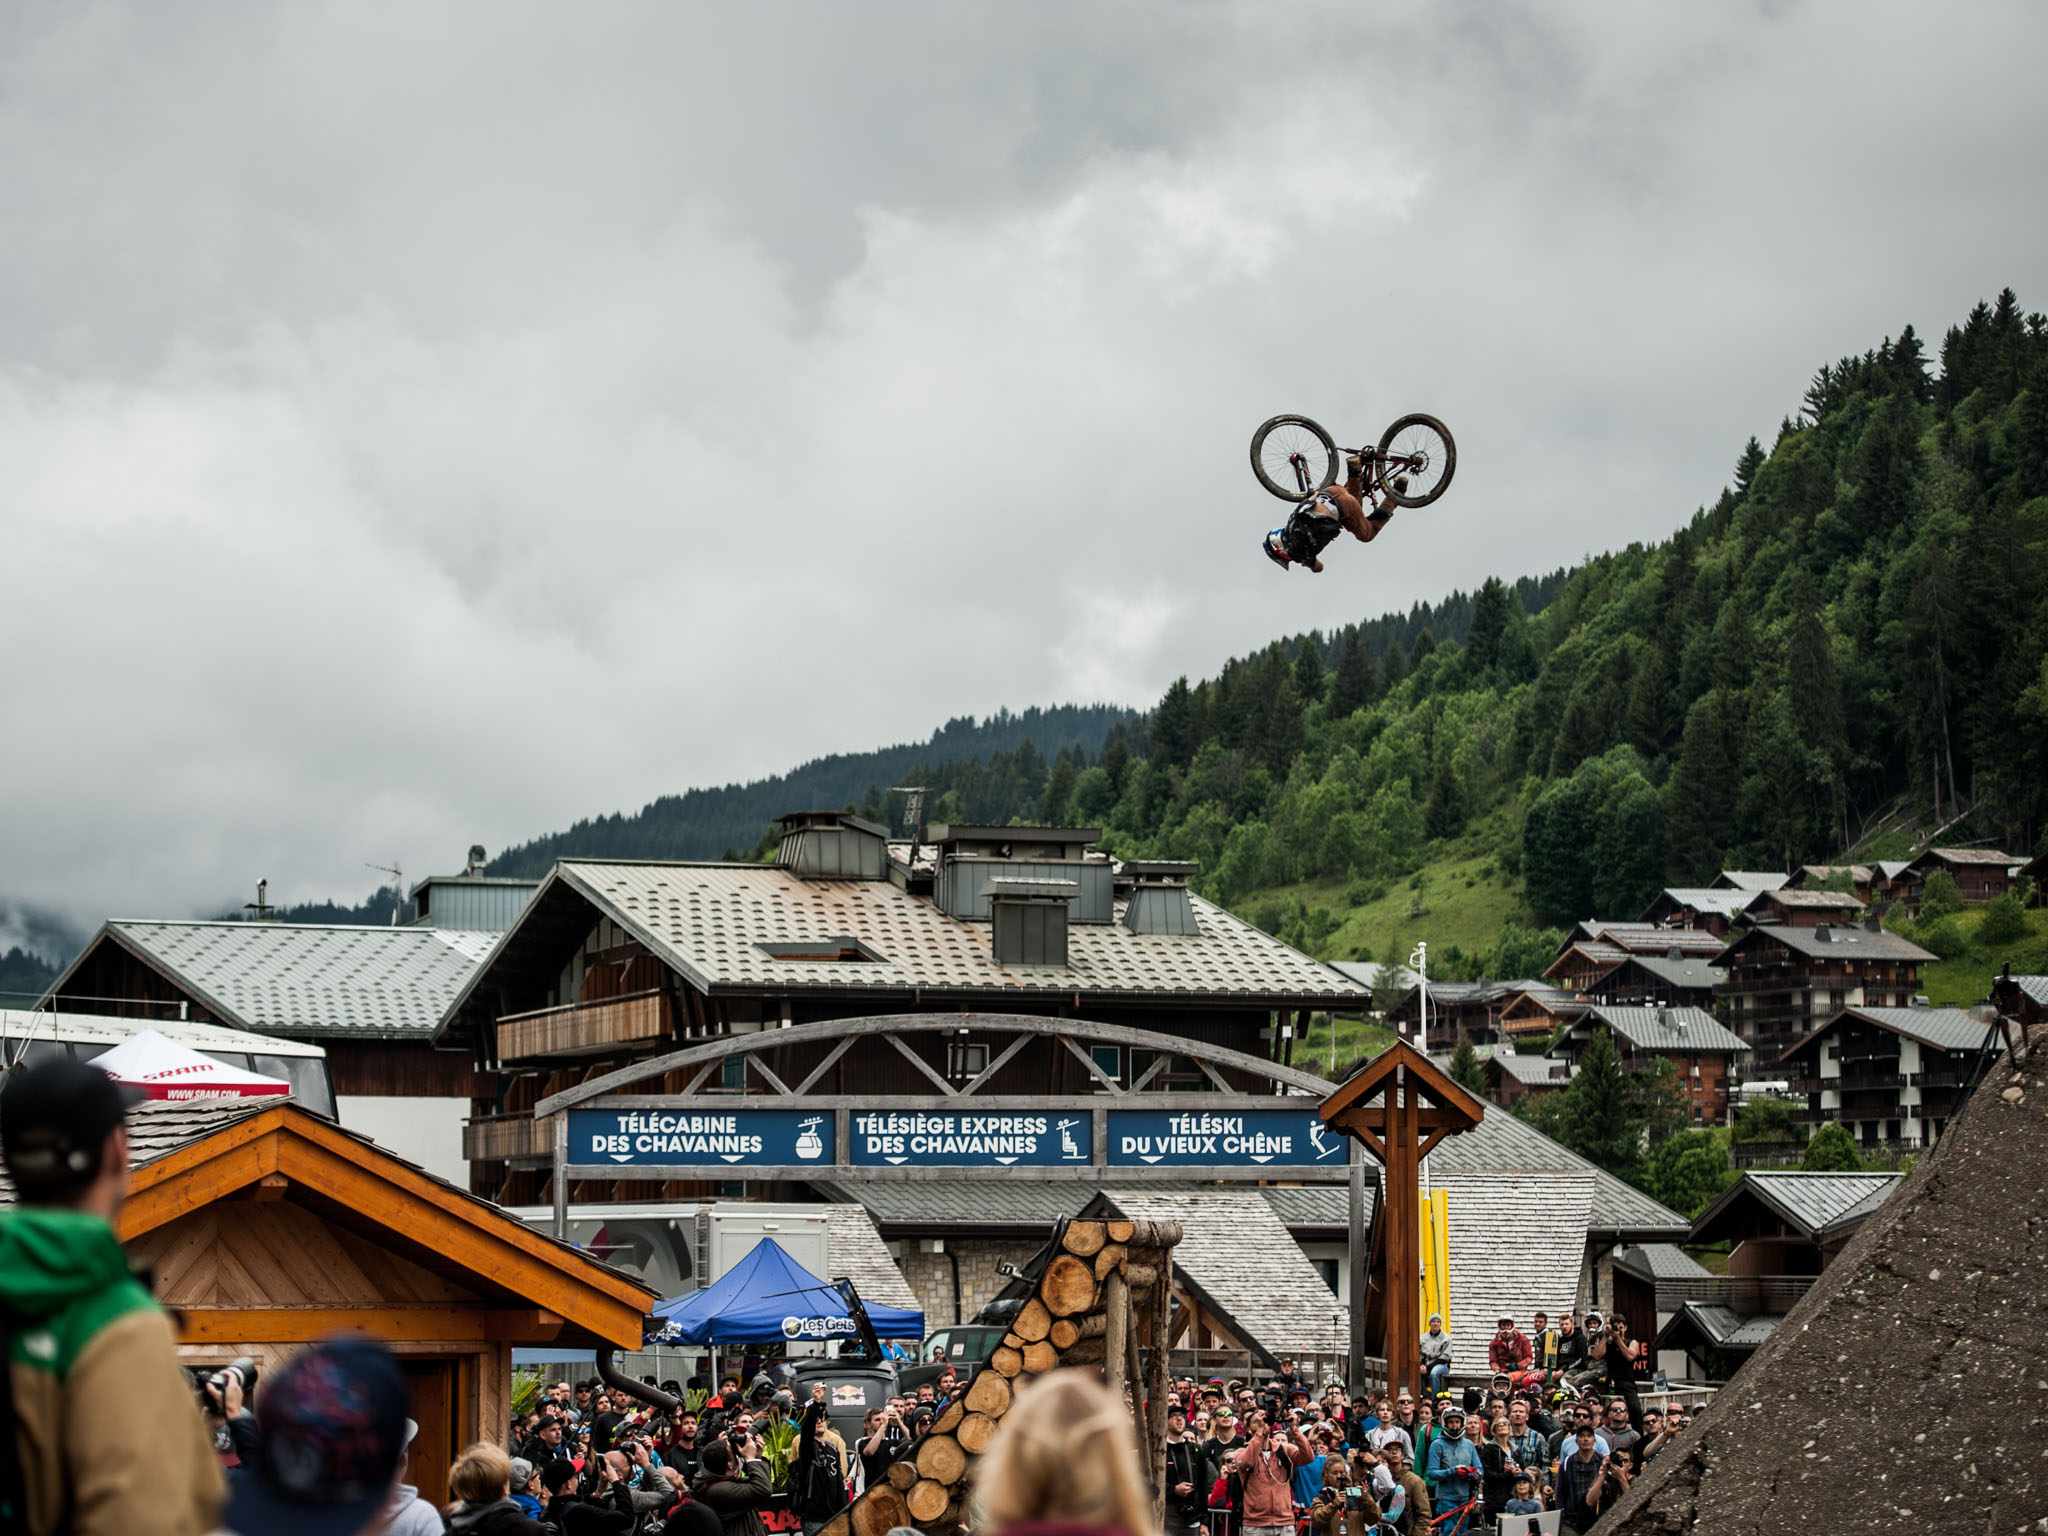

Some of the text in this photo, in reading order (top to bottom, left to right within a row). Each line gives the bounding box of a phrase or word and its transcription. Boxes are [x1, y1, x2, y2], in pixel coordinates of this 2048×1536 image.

[142, 1064, 214, 1081] SRAM
[167, 1089, 241, 1100] WWW.SRAM.COM
[617, 1112, 737, 1134] TÉLÉCABINE
[856, 1112, 1048, 1135] TÉLÉSIÈGE EXPRESS
[1169, 1112, 1243, 1135] TÉLÉSKI
[592, 1135, 763, 1153] DES CHAVANNES
[867, 1136, 1038, 1154] DES CHAVANNES
[1121, 1132, 1292, 1154] DU VIEUX CHÊNE
[803, 1319, 856, 1331] Les Gets
[727, 1360, 743, 1369] Red
